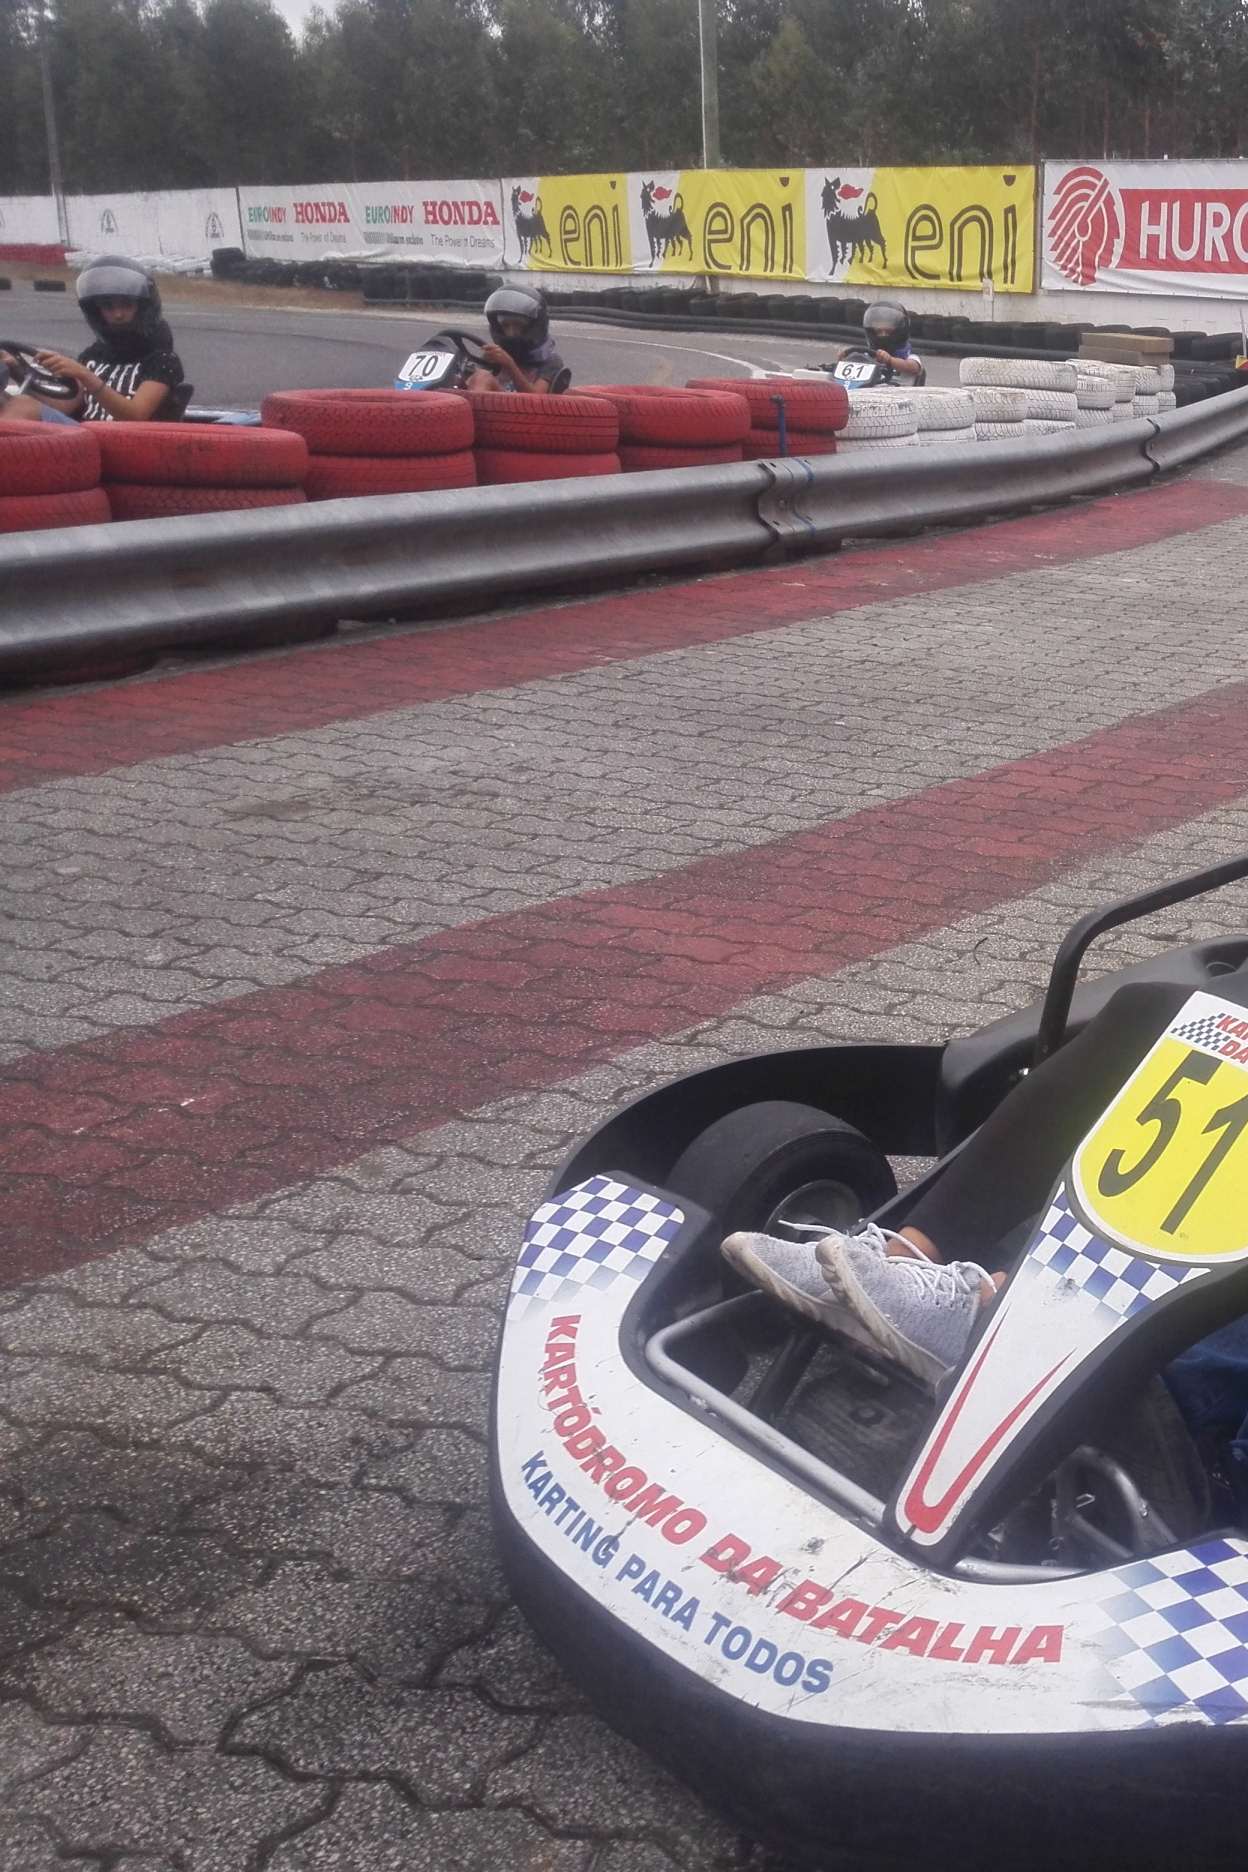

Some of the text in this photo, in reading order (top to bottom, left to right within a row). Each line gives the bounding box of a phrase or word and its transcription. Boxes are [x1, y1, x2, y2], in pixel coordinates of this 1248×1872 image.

[293, 201, 350, 224] HONDA
[422, 200, 501, 225] HONDA
[559, 180, 623, 268] eni
[702, 176, 794, 274] eni
[904, 174, 1017, 284] eni
[408, 355, 439, 377] 70
[842, 364, 865, 378] 61
[543, 1314, 1065, 1665] KARTÓDROMO DA BATALHA
[521, 1450, 835, 1694] KARTING PARA TODOS
